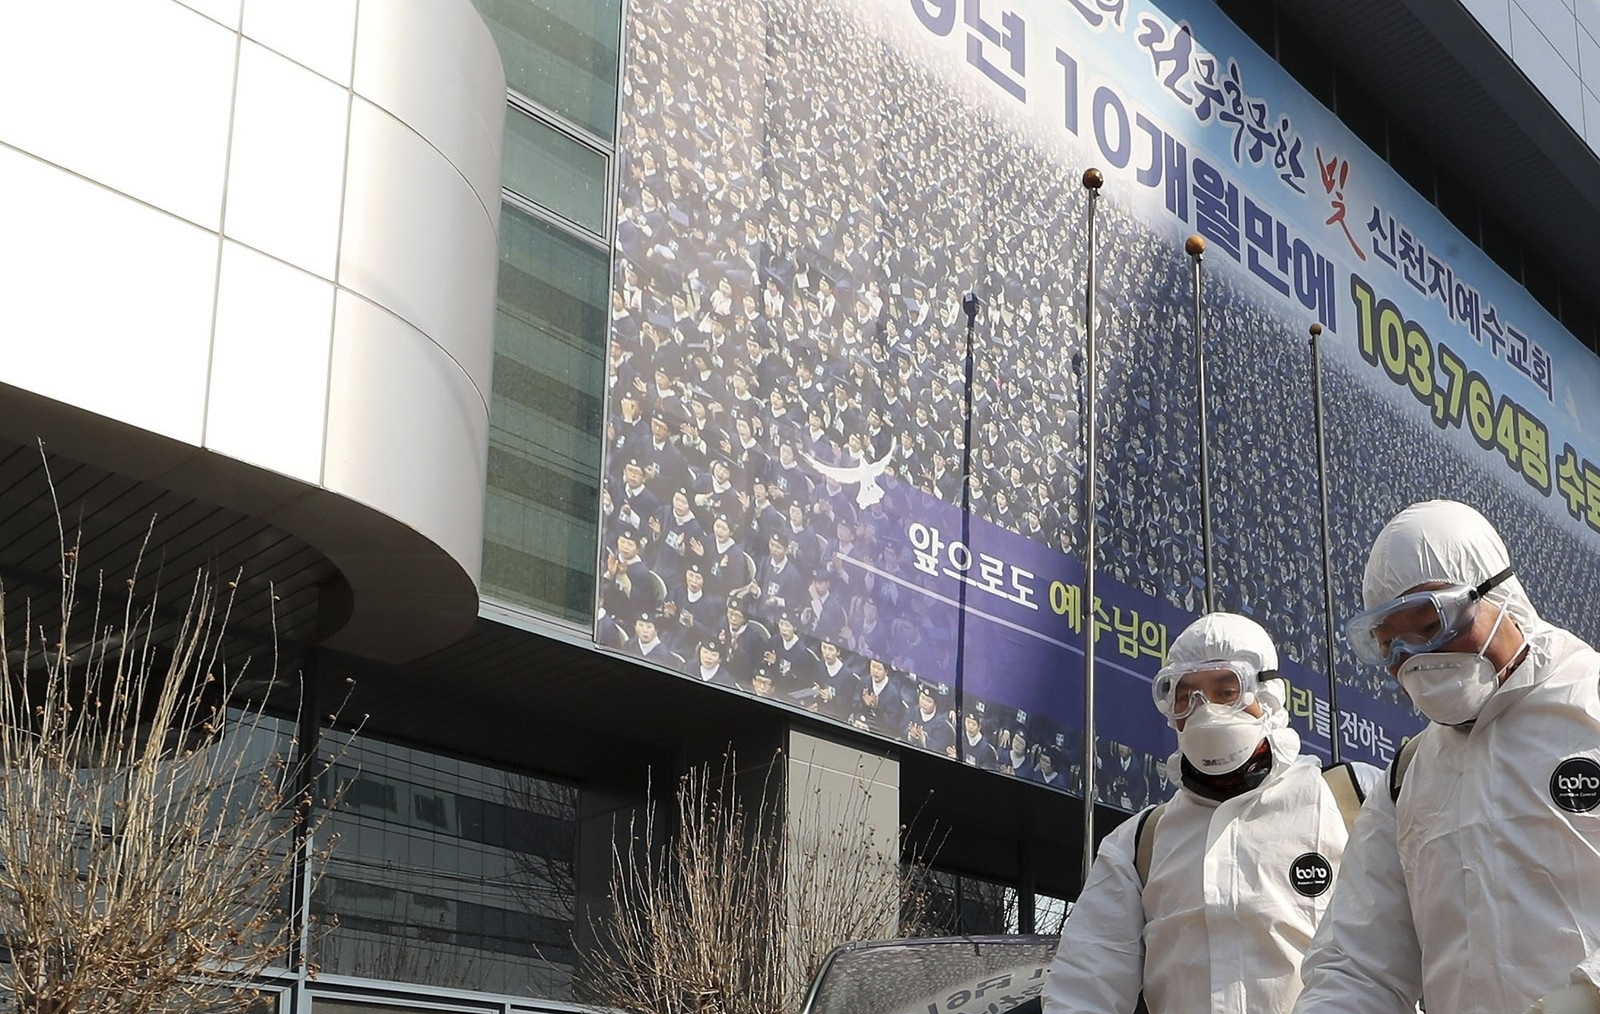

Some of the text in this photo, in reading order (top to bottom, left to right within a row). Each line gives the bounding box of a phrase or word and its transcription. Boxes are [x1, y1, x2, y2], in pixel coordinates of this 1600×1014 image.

[1056, 47, 1336, 334] 10개월만에
[1352, 274, 1550, 494] 103,764명
[1367, 205, 1553, 402] 신천지예수교회
[909, 523, 1396, 763] 앞으로도 예수님의 리를 전하는
[1296, 866, 1327, 879] boho
[1559, 773, 1599, 789] boho
